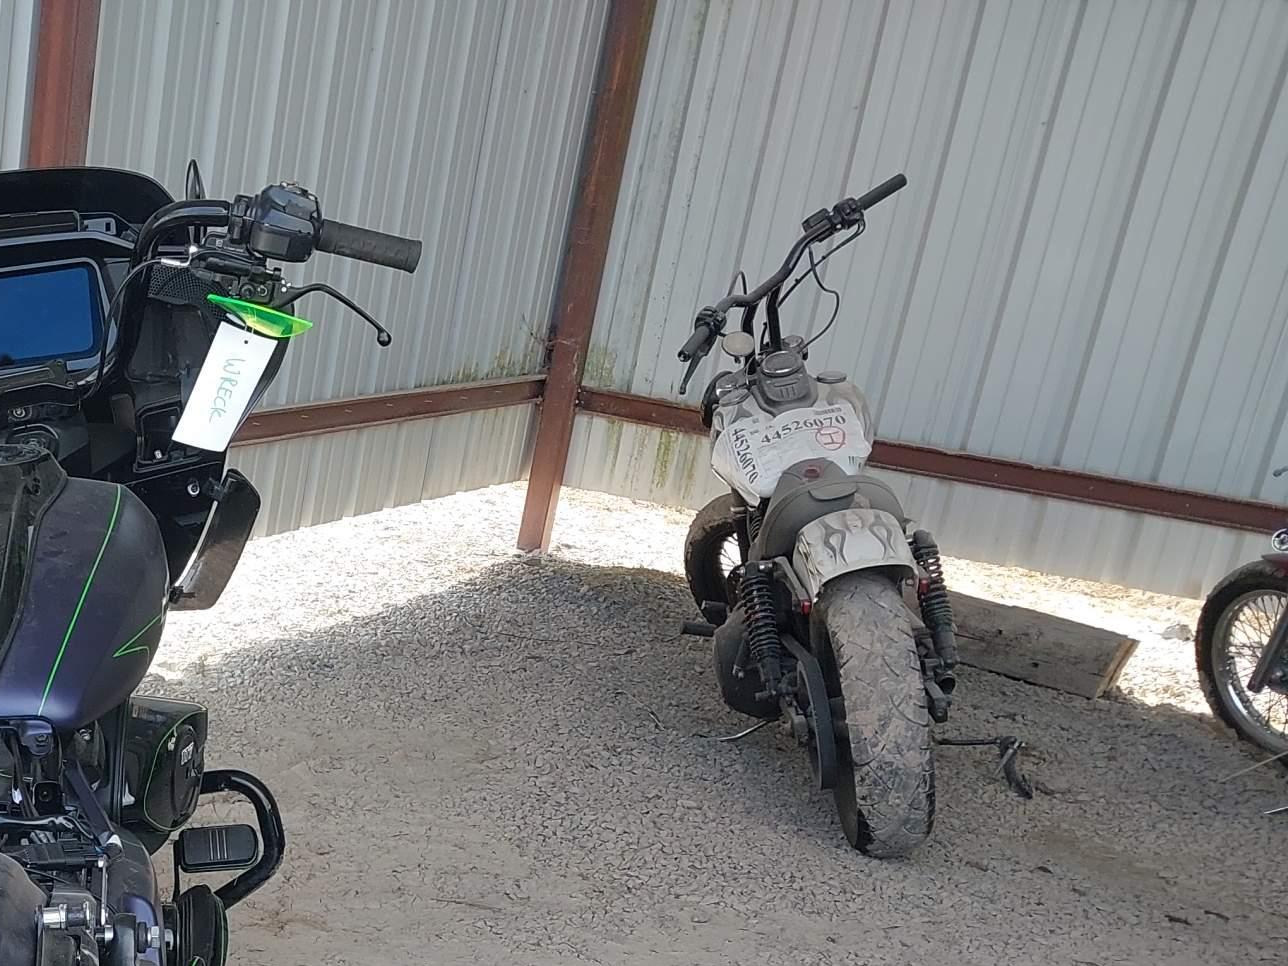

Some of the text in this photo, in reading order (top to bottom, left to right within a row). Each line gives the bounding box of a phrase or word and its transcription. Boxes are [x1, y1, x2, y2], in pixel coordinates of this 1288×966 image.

[210, 358, 246, 423] WRECK
[731, 428, 759, 484] 44526070
[761, 415, 846, 444] 44526070
